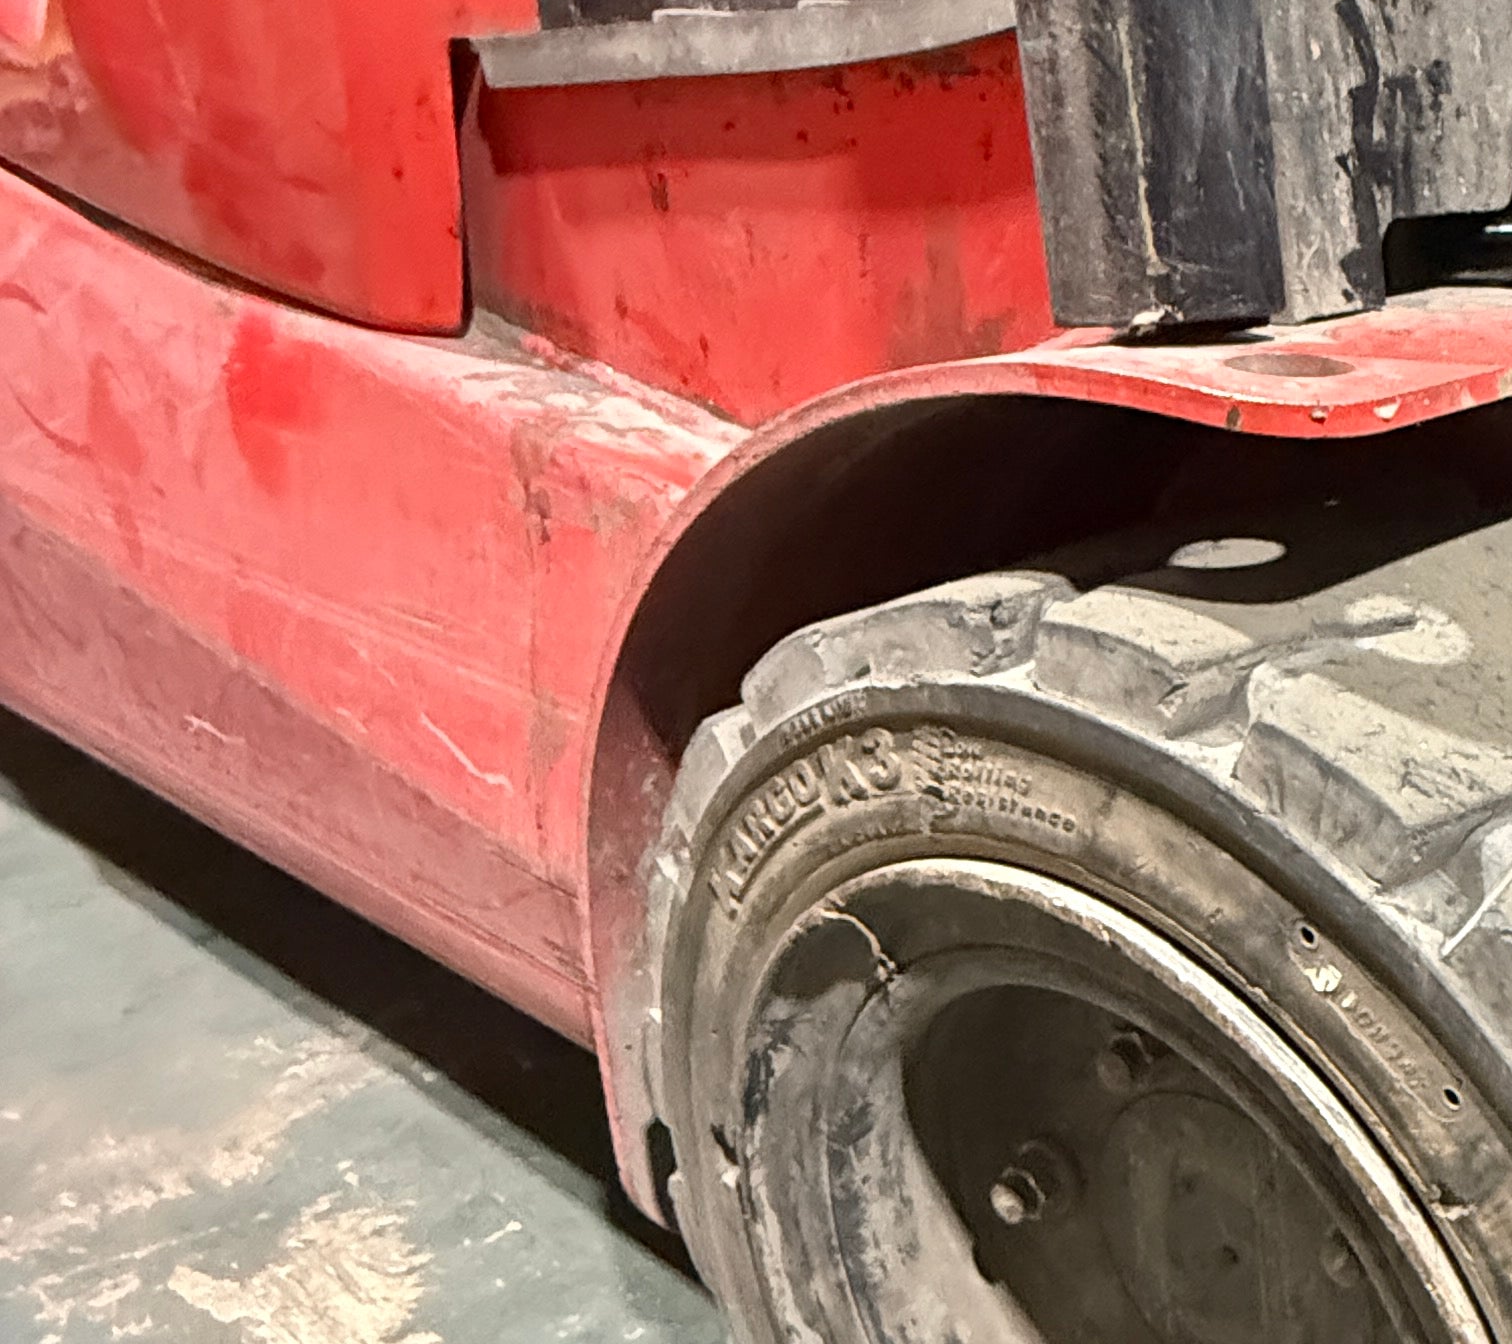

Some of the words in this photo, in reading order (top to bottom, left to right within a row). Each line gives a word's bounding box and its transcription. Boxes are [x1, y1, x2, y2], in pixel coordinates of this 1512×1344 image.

[710, 765, 826, 920] KARGO
[824, 727, 902, 810] K3
[946, 784, 1078, 835] Resistance
